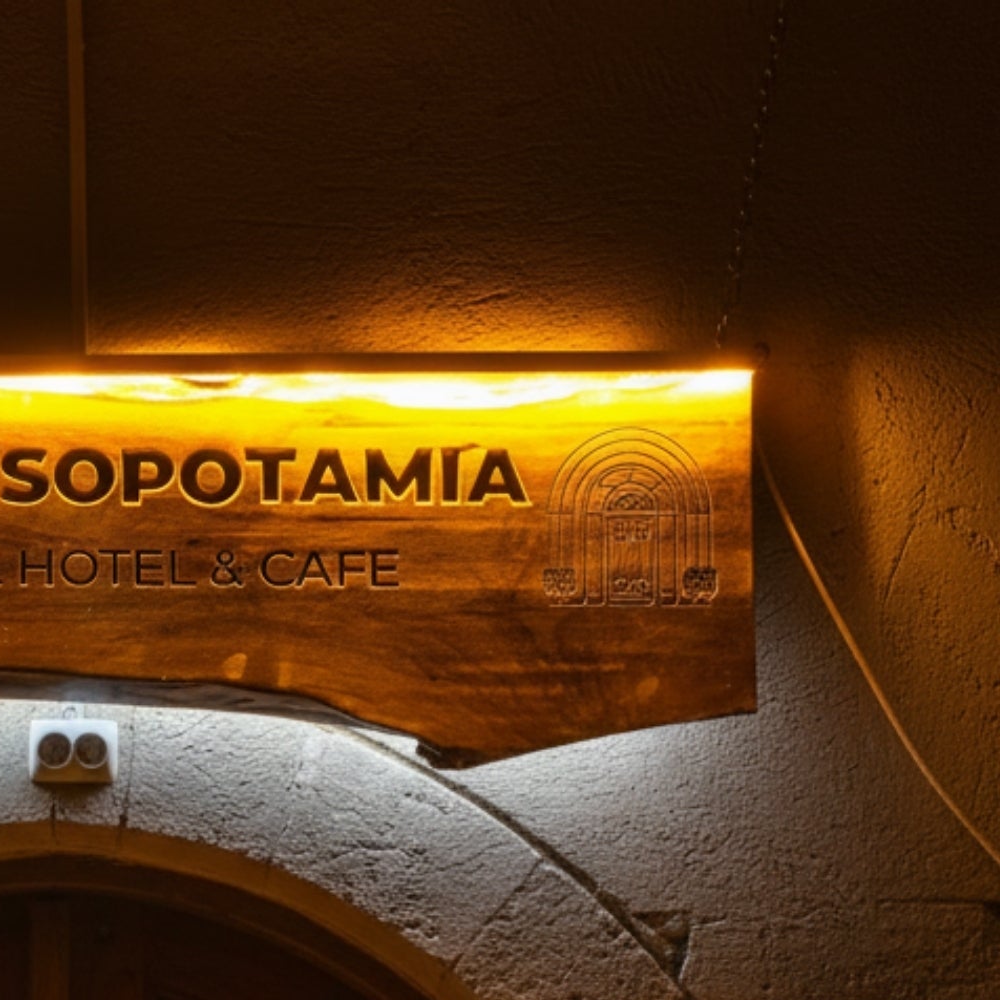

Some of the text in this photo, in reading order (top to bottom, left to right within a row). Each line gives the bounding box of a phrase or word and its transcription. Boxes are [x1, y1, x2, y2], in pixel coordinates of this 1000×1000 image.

[18, 549, 197, 588] HOTEL
[211, 550, 244, 588] &
[258, 550, 401, 589] CAFE
